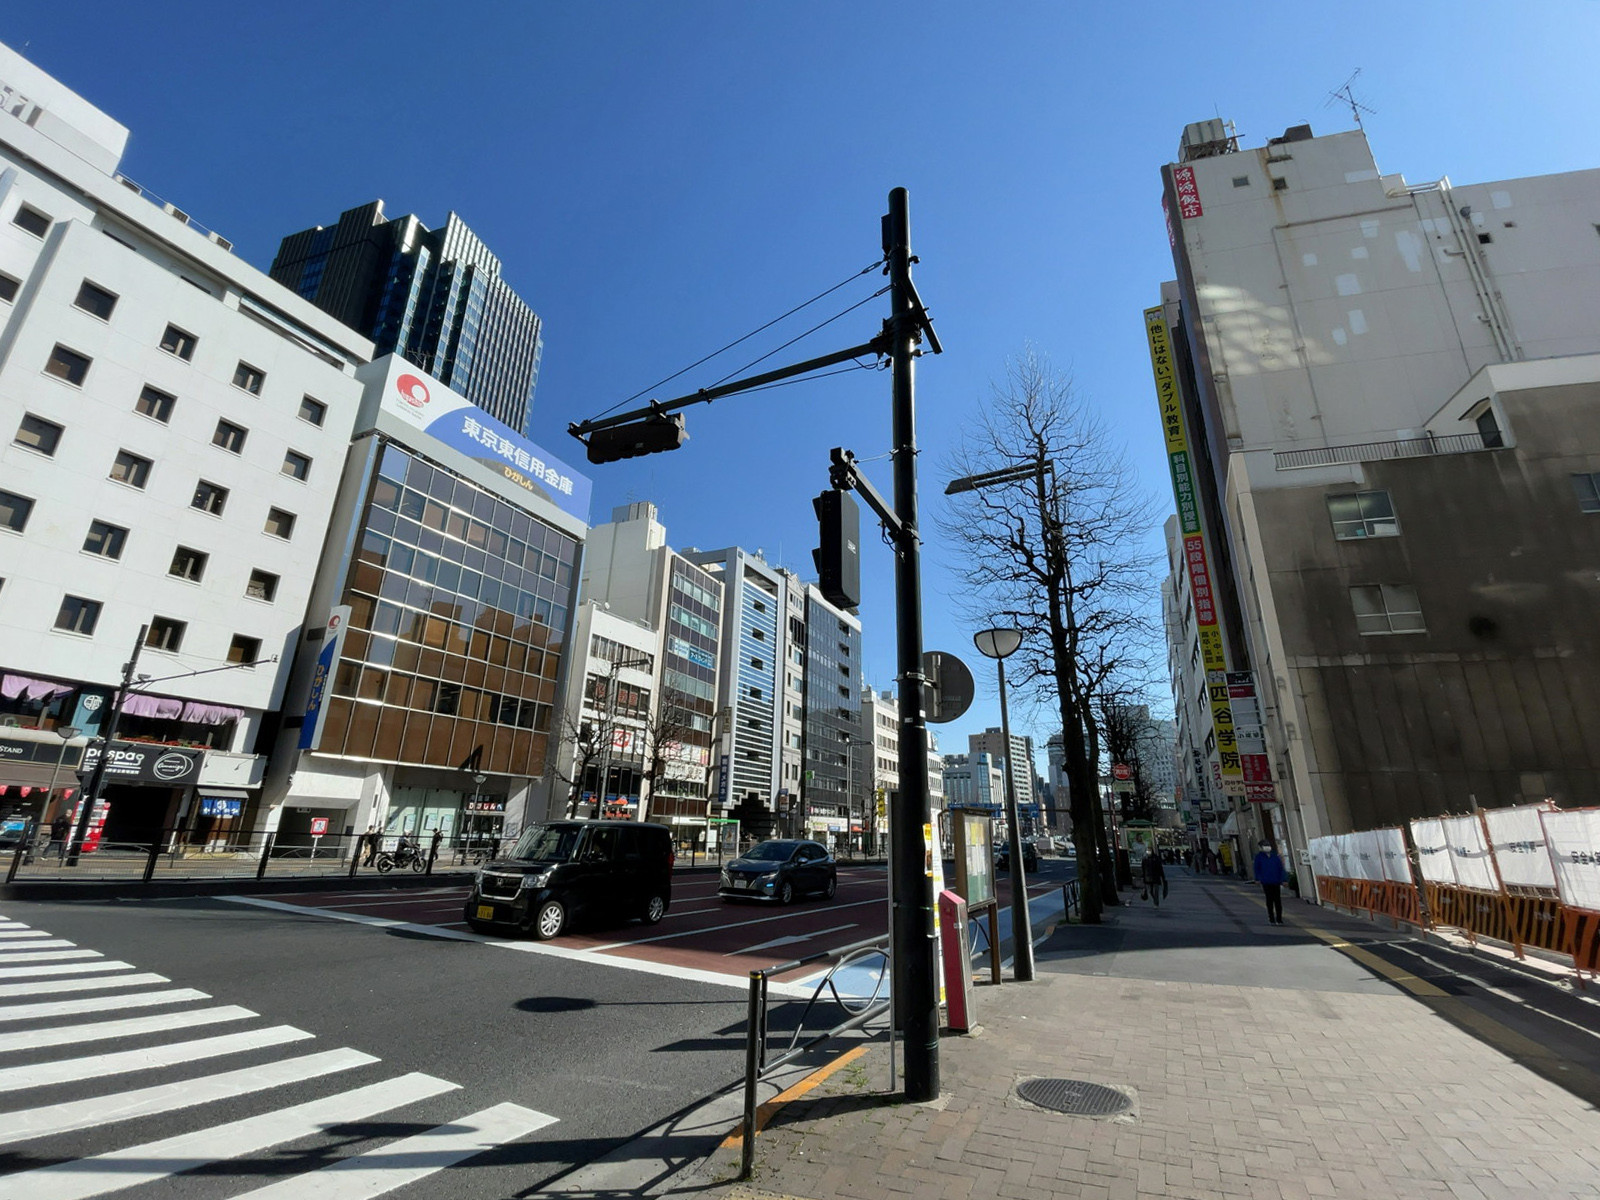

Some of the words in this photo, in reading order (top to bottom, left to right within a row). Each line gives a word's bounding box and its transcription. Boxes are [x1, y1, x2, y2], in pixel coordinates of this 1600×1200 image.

[461, 414, 574, 497] 東京東信用金庫
[503, 466, 534, 491] ひがしん
[1173, 453, 1197, 531] 科目別能力別授業
[1187, 540, 1214, 622] 55段階個別指導
[308, 664, 325, 711] ひがしん
[1210, 685, 1241, 769] 四谷学院
[1213, 763, 1224, 790] クスリ
